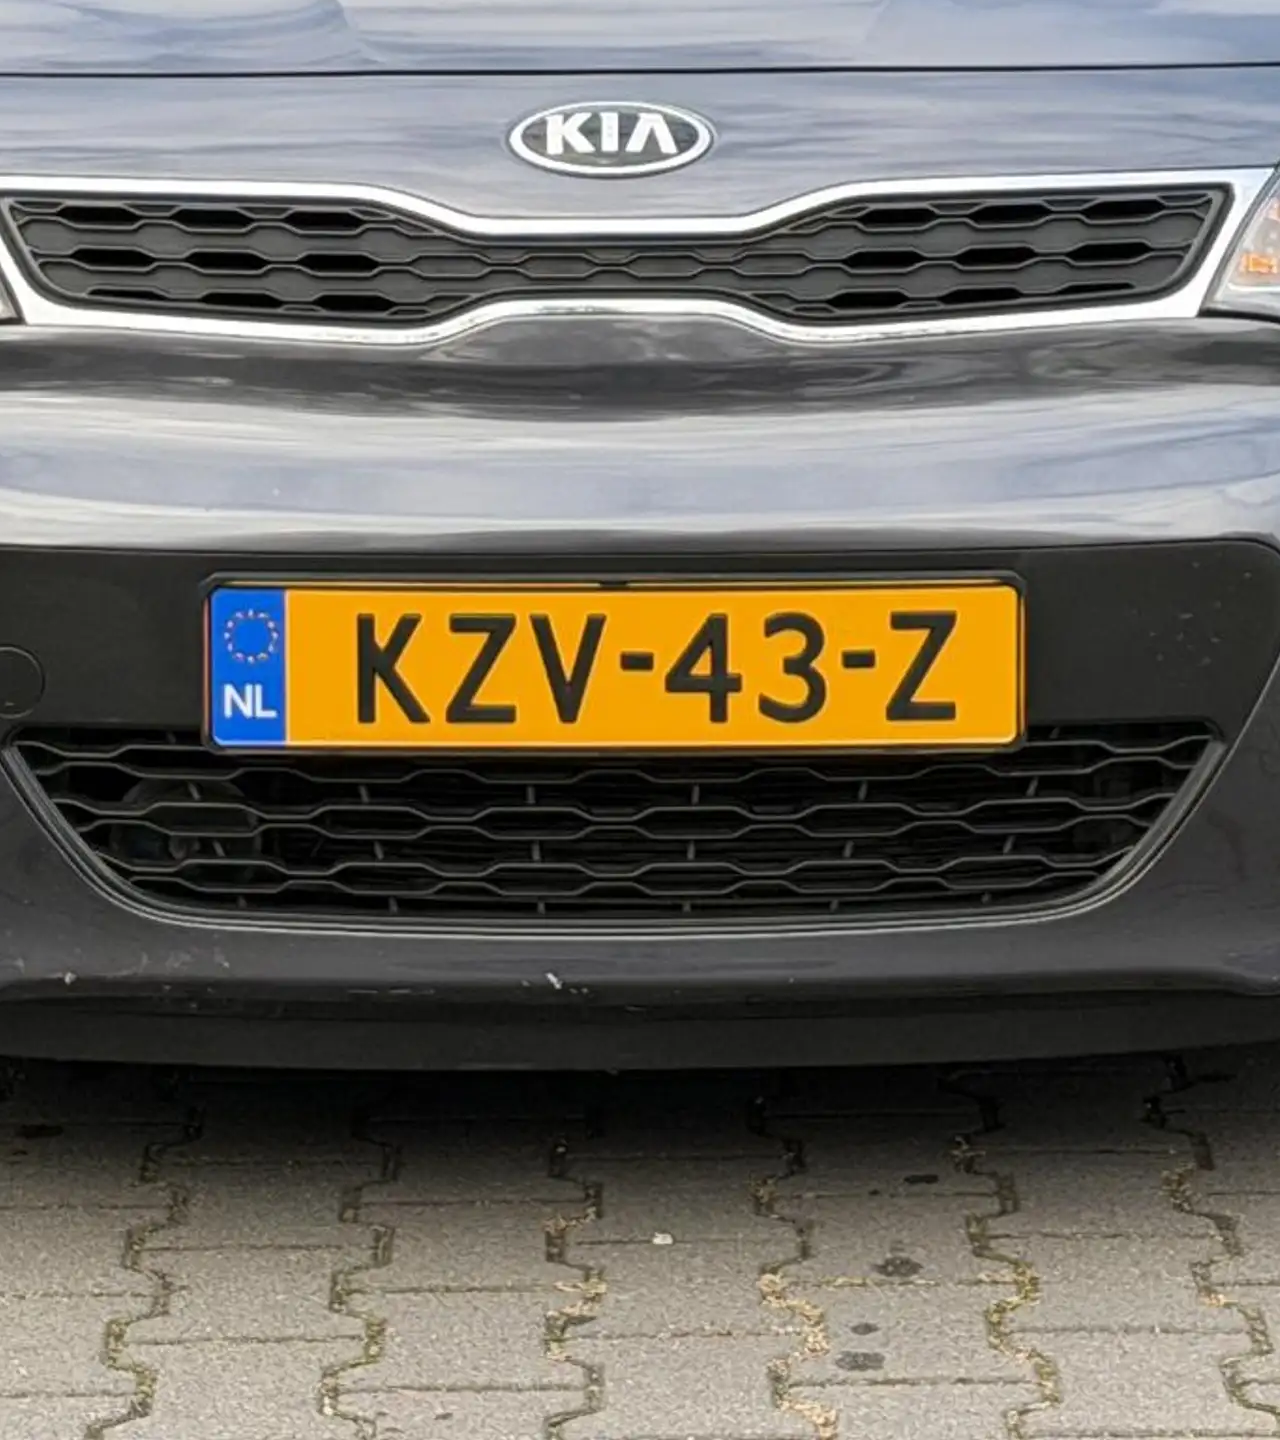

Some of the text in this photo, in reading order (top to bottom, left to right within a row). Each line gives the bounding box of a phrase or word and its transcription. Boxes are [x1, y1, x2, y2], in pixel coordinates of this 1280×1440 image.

[545, 111, 679, 155] KIA
[354, 609, 958, 725] KZV-43-Z
[223, 682, 277, 718] NL
